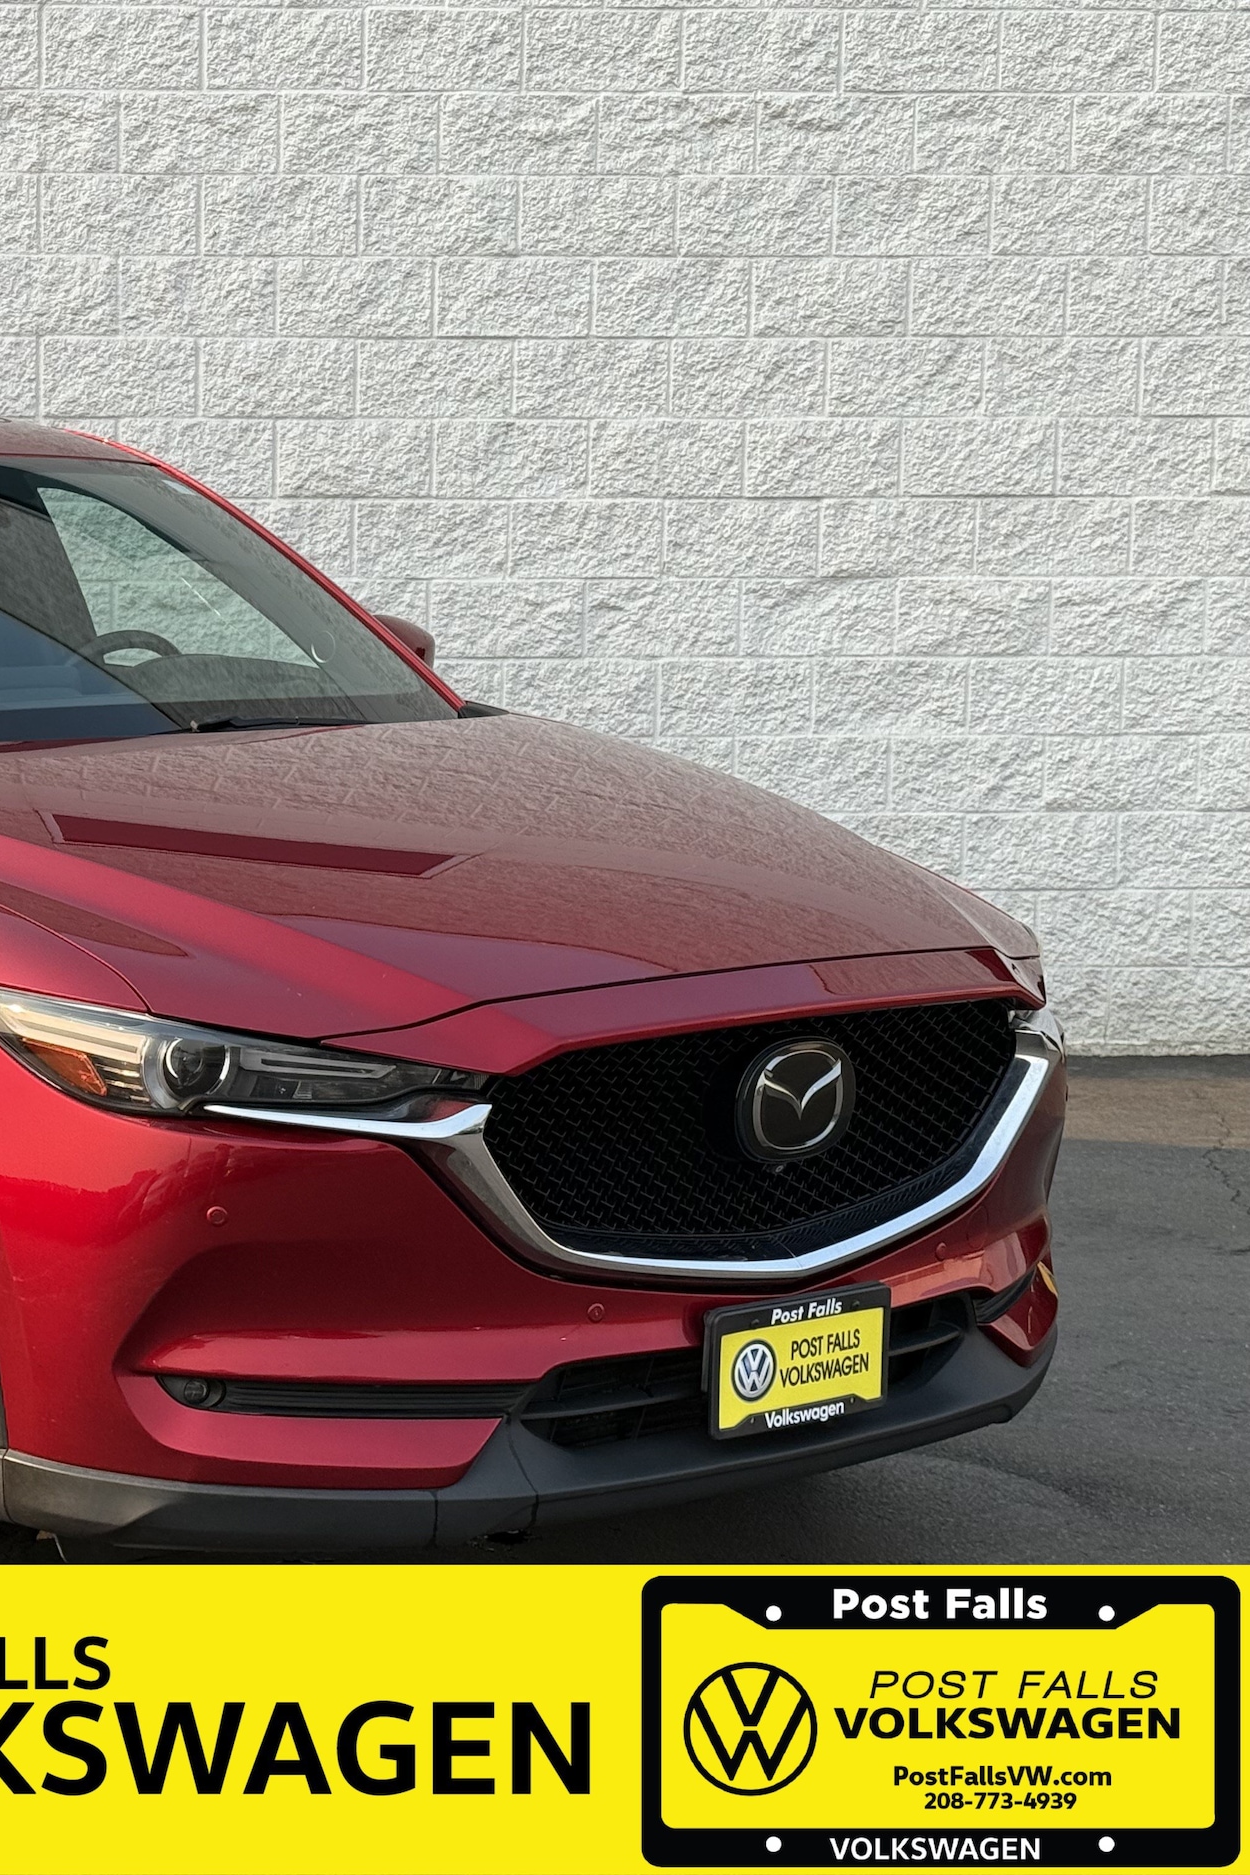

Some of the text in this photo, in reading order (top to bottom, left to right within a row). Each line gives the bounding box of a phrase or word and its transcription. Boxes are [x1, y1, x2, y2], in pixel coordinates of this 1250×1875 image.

[771, 1297, 843, 1326] Post Falls
[791, 1328, 861, 1361] POST FALLS
[779, 1352, 869, 1388] VOLKSWAGEN
[764, 1401, 845, 1429] Volkswagen
